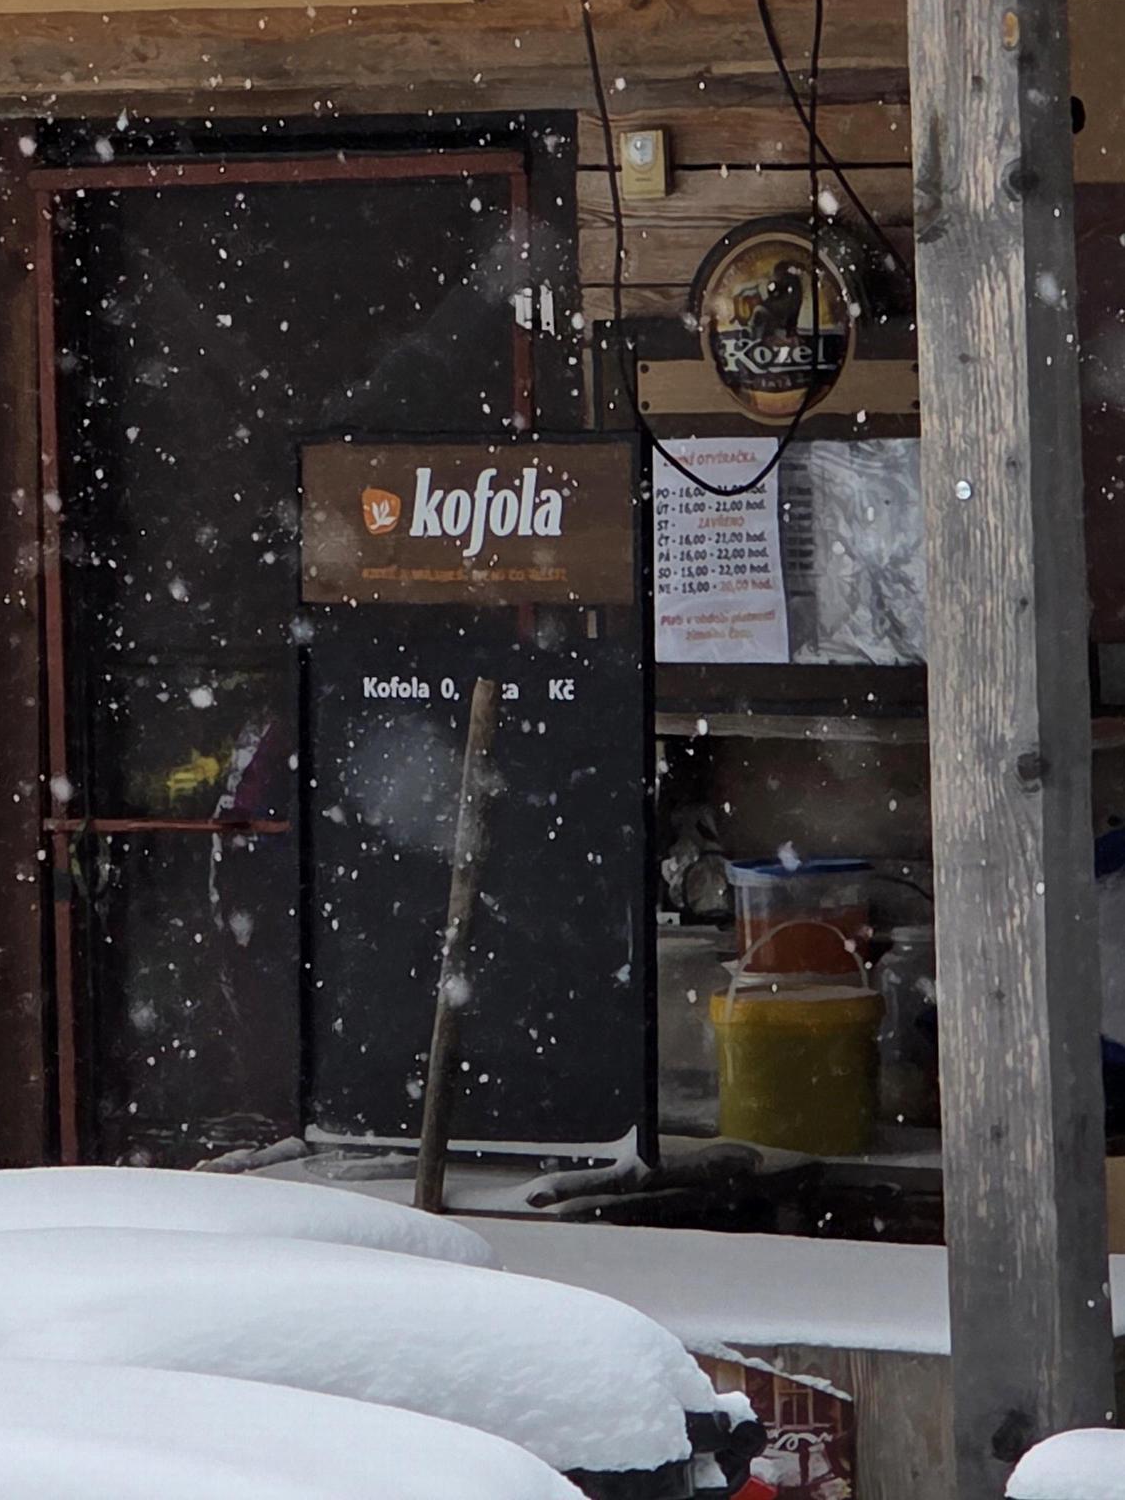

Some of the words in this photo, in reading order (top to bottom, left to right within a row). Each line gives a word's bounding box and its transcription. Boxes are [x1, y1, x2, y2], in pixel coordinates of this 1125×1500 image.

[721, 337, 825, 374] Kozel
[656, 488, 670, 498] PO
[408, 467, 563, 557] kofola
[657, 501, 670, 515] ÚT
[679, 501, 706, 515] 16,00
[715, 500, 743, 513] 21,00
[657, 520, 670, 532] ST
[658, 533, 670, 547] ČT
[679, 534, 706, 546] 16,00
[715, 532, 743, 545] 21,00
[680, 549, 707, 562] 16,00
[717, 548, 745, 561] 22,00
[658, 567, 672, 579] SO
[681, 565, 709, 579] 15,00
[719, 564, 747, 577] 22,00
[363, 676, 430, 699] Kofola
[548, 679, 575, 700] Kč
